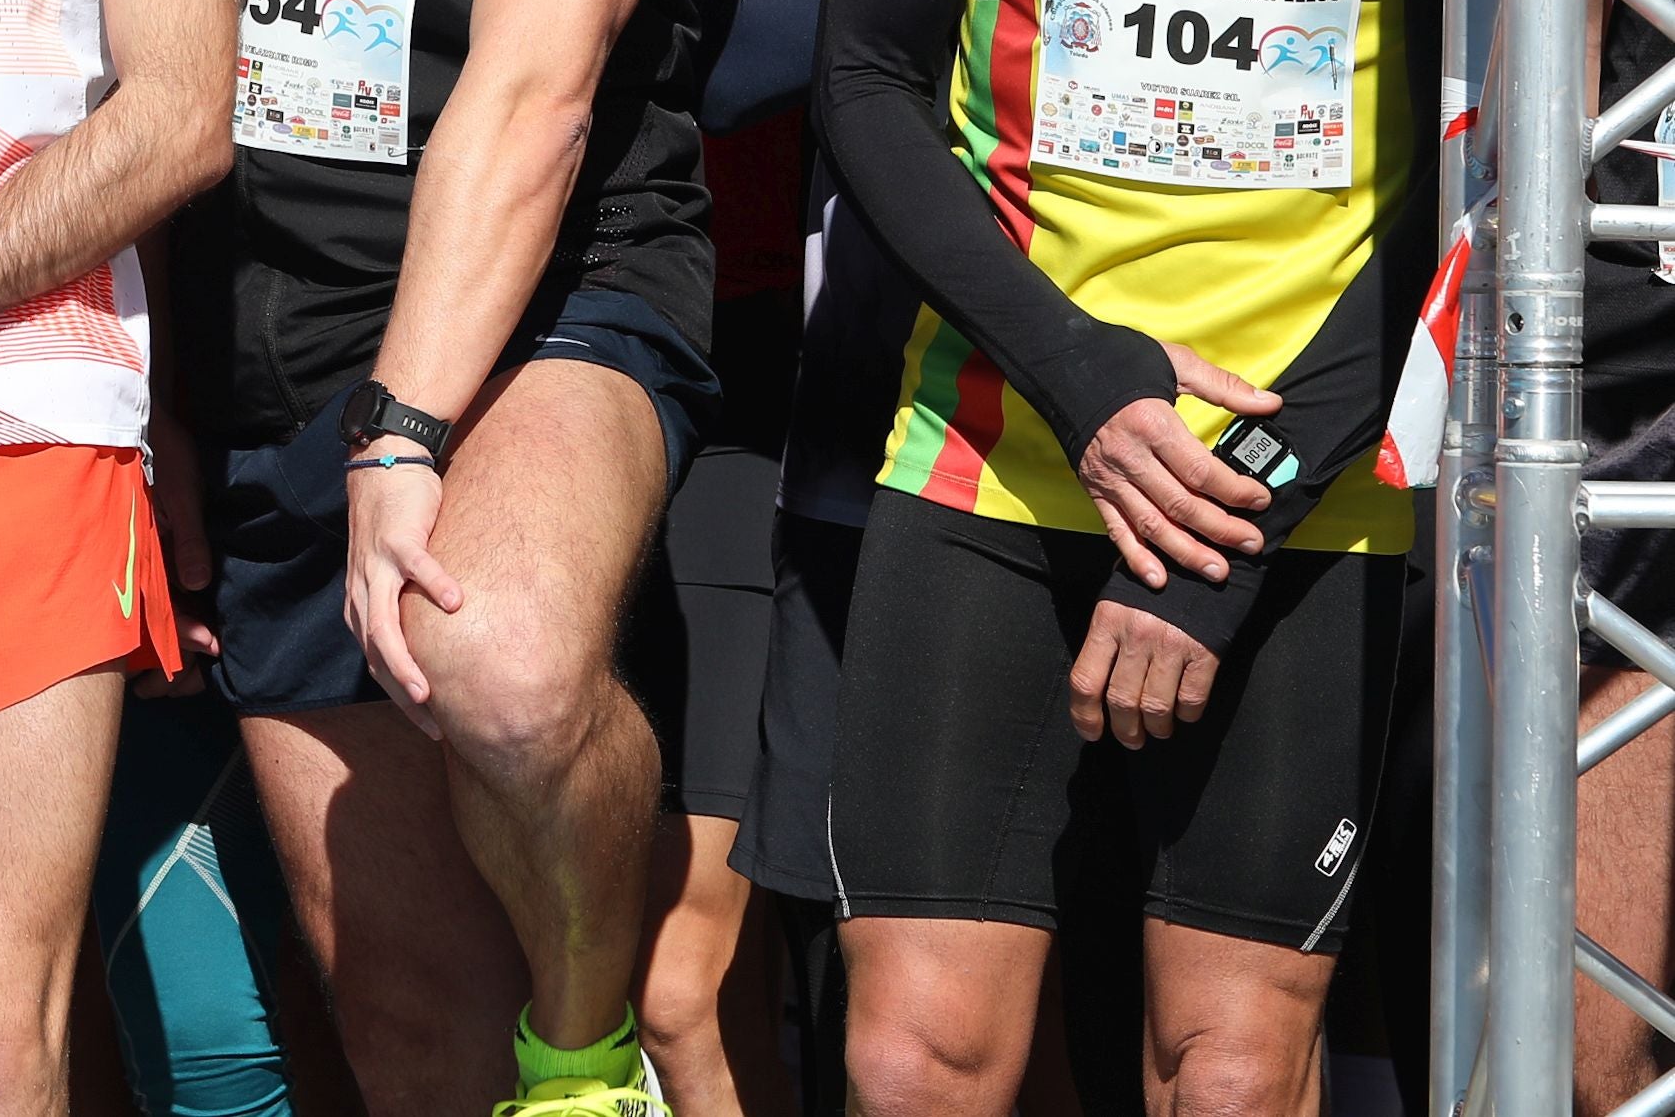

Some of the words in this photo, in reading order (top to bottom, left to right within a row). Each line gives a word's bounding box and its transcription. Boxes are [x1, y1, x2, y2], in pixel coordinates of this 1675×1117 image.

[1124, 3, 1259, 71] 104
[1140, 82, 1179, 95] VICTOR
[1180, 87, 1221, 100] SUAREZ
[1223, 92, 1241, 103] GIL
[1245, 437, 1271, 464] 00:00
